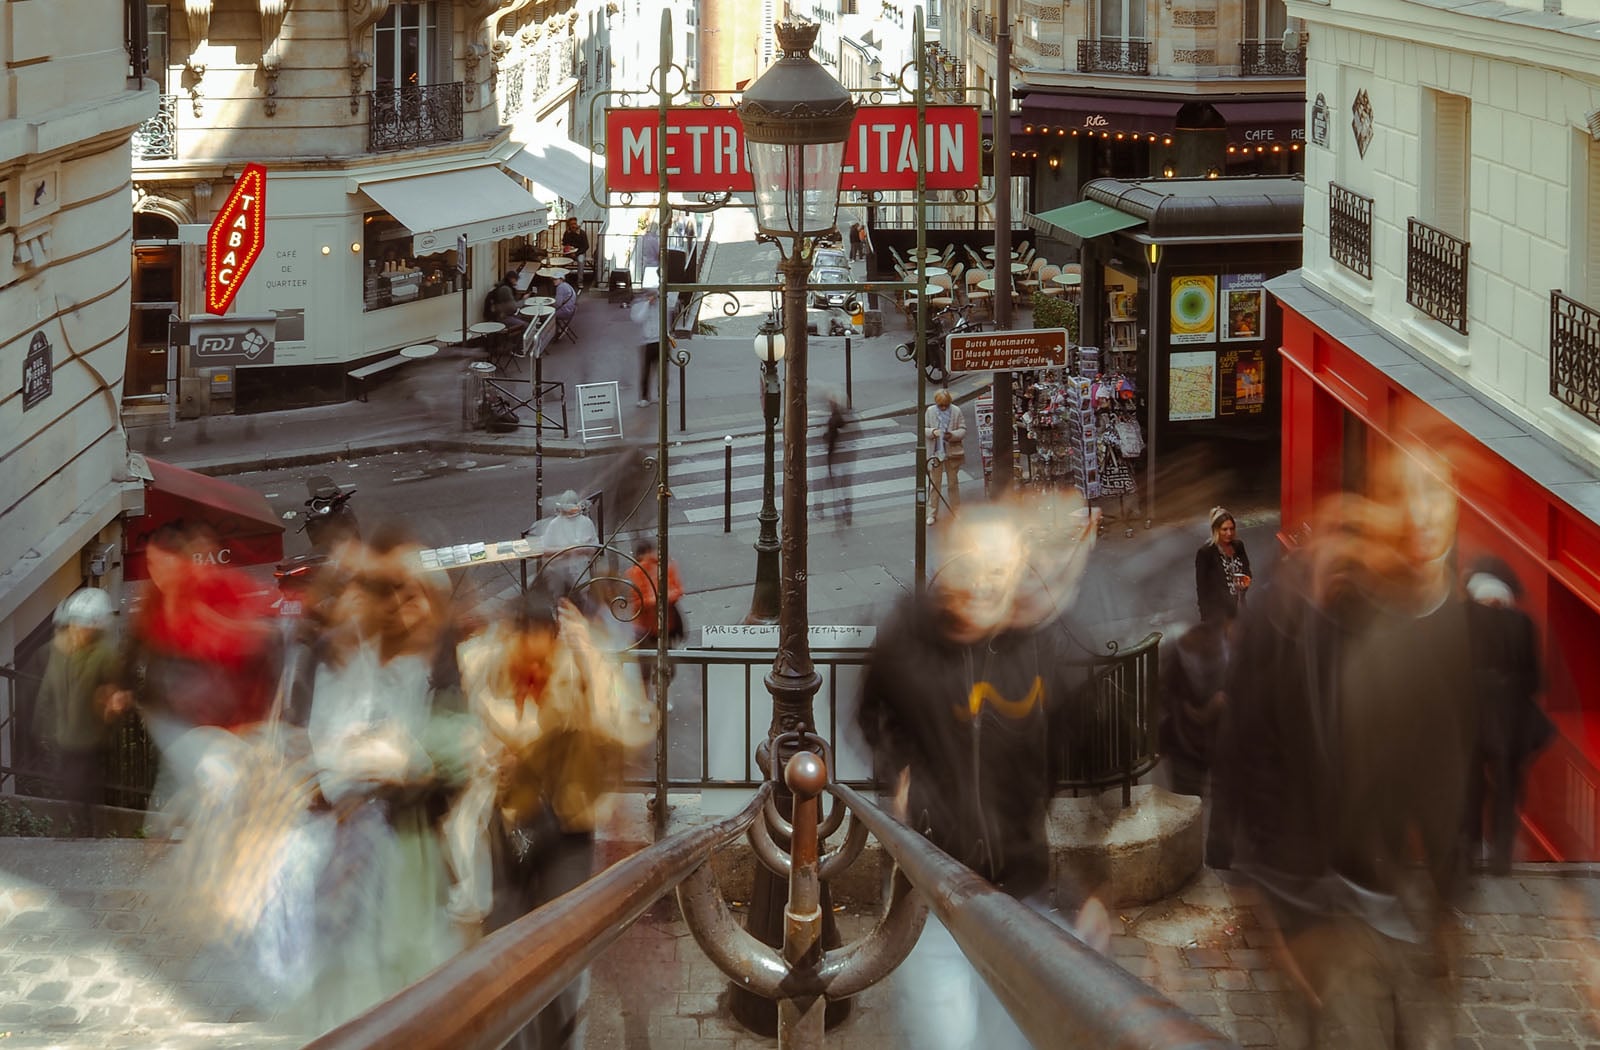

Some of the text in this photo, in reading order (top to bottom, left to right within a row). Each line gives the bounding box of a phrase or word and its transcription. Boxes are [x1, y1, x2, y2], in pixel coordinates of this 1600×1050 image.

[1084, 115, 1109, 128] Rita
[621, 123, 965, 176] METRLITAIN
[218, 194, 255, 285] TABAC
[281, 265, 293, 273] DE
[266, 279, 308, 289] QUARTIER
[200, 337, 235, 352] FDJ
[965, 338, 1035, 348] Butte Montmartre
[993, 347, 1039, 357] Montmartre
[965, 360, 979, 368] Par
[981, 359, 989, 367] la
[705, 626, 739, 636] PARIS
[759, 626, 780, 635] ULT
[808, 626, 838, 641] TETIA
